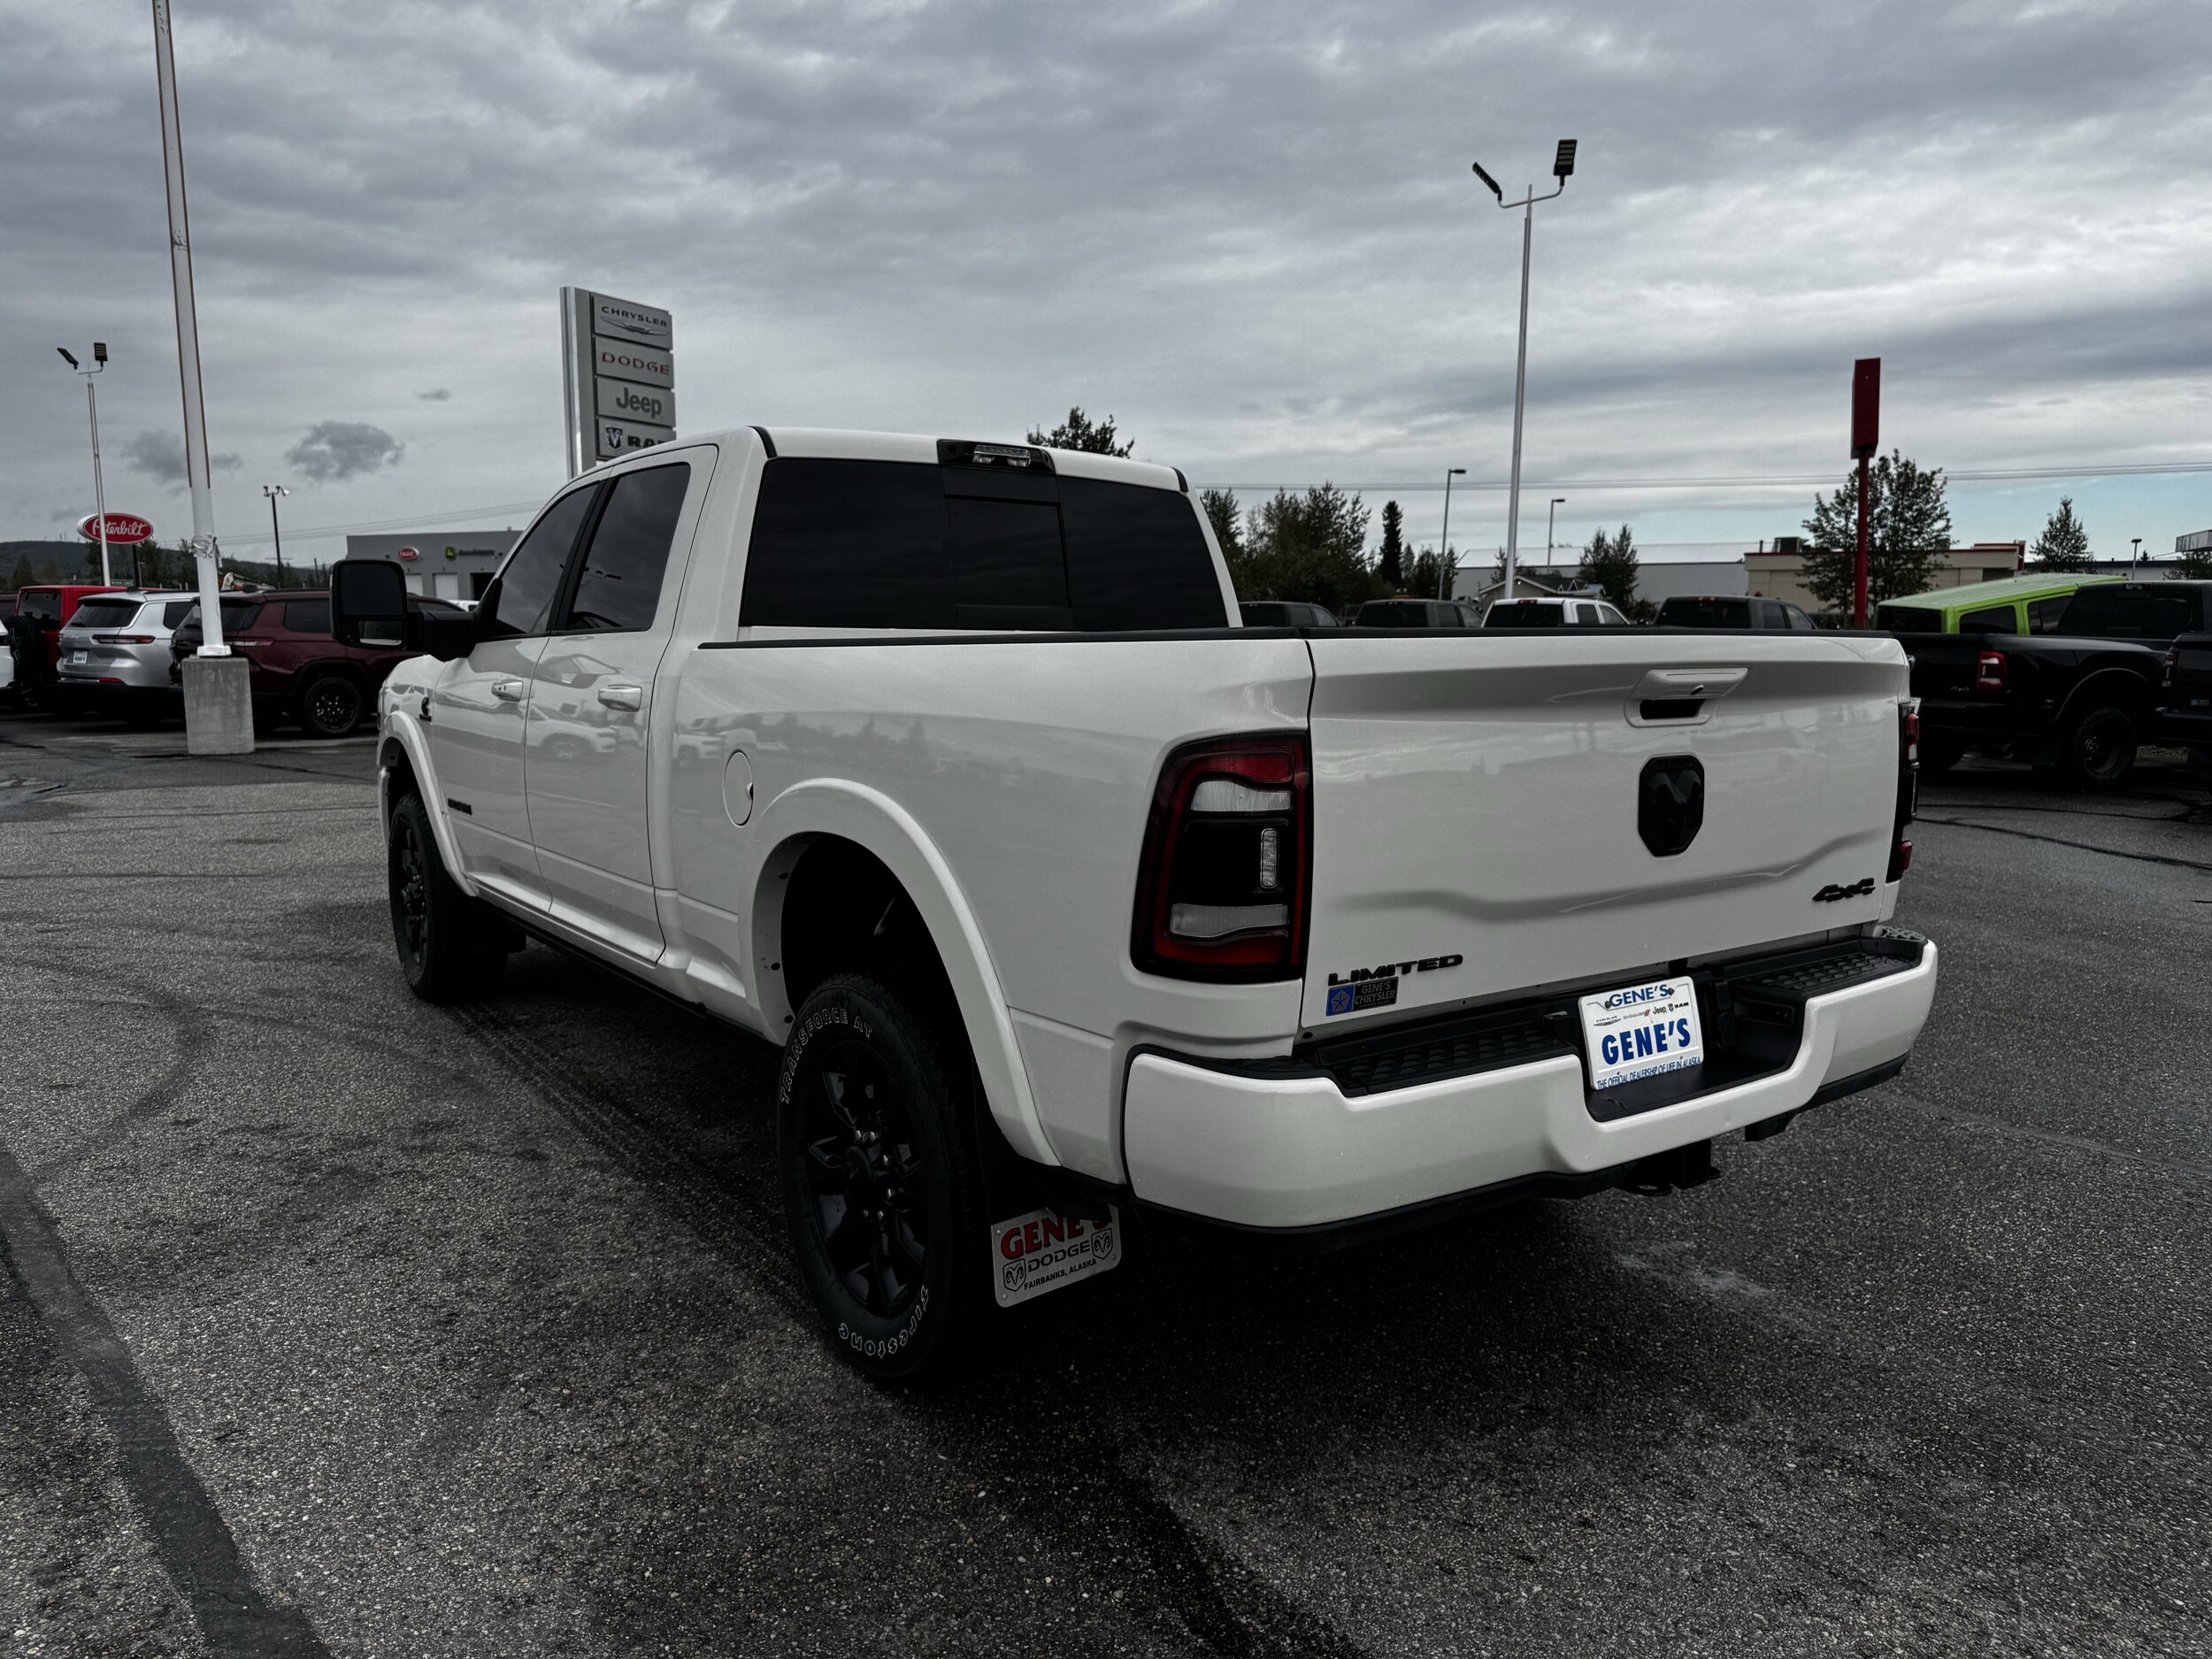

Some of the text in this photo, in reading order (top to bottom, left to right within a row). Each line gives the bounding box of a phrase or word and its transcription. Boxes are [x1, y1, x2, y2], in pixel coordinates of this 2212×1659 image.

[602, 306, 667, 326] CHRYSLER
[602, 352, 670, 375] DODGE
[616, 388, 662, 419] Jeep
[627, 435, 665, 448] RA
[92, 518, 147, 535] Pterbilt
[1328, 954, 1463, 986] LIMITED
[1355, 990, 1395, 1005] CHRYSLER
[1361, 981, 1391, 994] GENE'S
[1609, 984, 1670, 1007] GENE'S
[780, 1008, 872, 1104] TRANSFORCE AT
[1601, 1018, 1691, 1065] GENE'S
[1597, 1080, 1607, 1089] THE
[1608, 1074, 1628, 1087] OFFICIAL
[1630, 1066, 1657, 1079] DEALERSHIP
[1658, 1064, 1665, 1074] OF
[1676, 1061, 1681, 1070] IN
[1683, 1056, 1701, 1068] ALASKA
[1001, 1217, 1109, 1260] GENE
[1027, 1240, 1091, 1272] DODGE
[1024, 1258, 1097, 1290] FAIRBANKS, ALASKA
